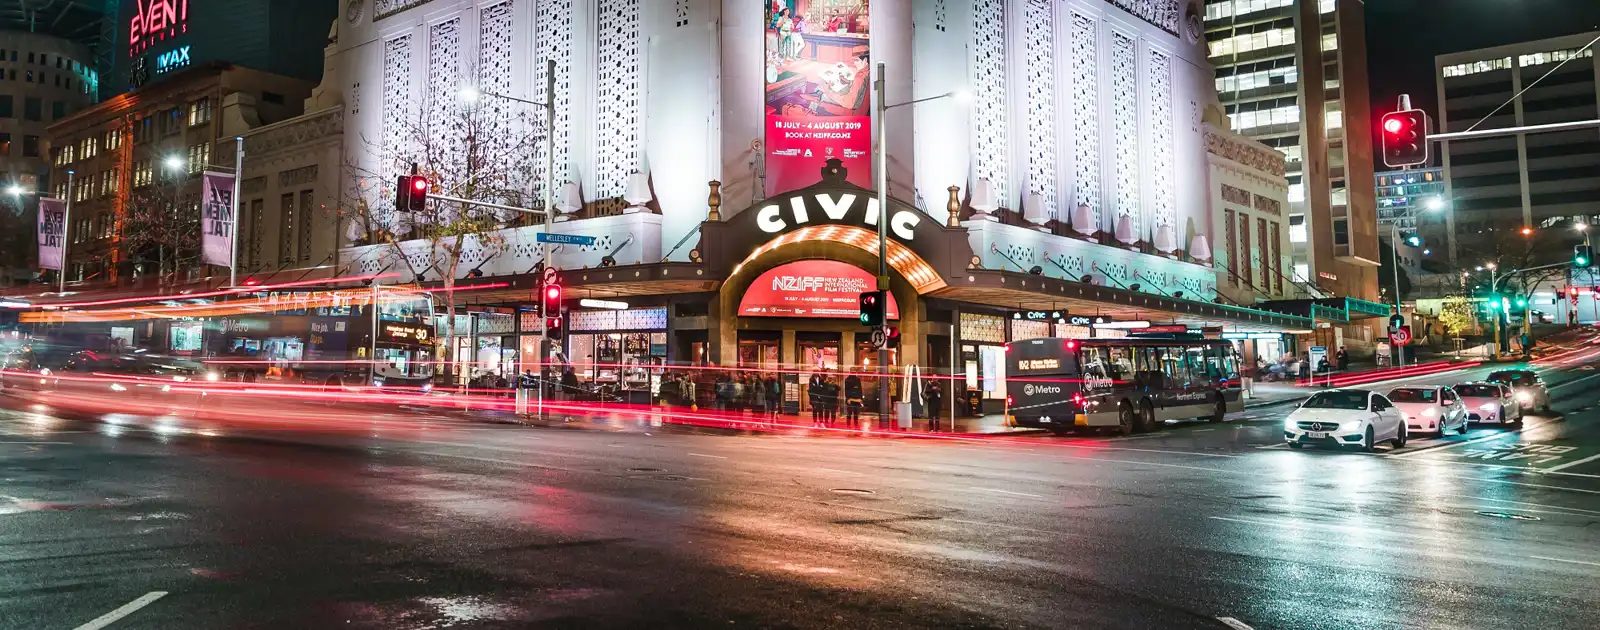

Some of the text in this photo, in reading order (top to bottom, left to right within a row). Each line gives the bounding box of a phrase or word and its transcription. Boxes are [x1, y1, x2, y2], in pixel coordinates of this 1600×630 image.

[157, 46, 190, 69] IMAX
[757, 193, 921, 241] CIVIC
[772, 276, 825, 291] NZIFF
[228, 319, 249, 332] Metro
[415, 328, 427, 340] 30
[1092, 376, 1113, 388] Metro
[1035, 385, 1060, 394] Metro
